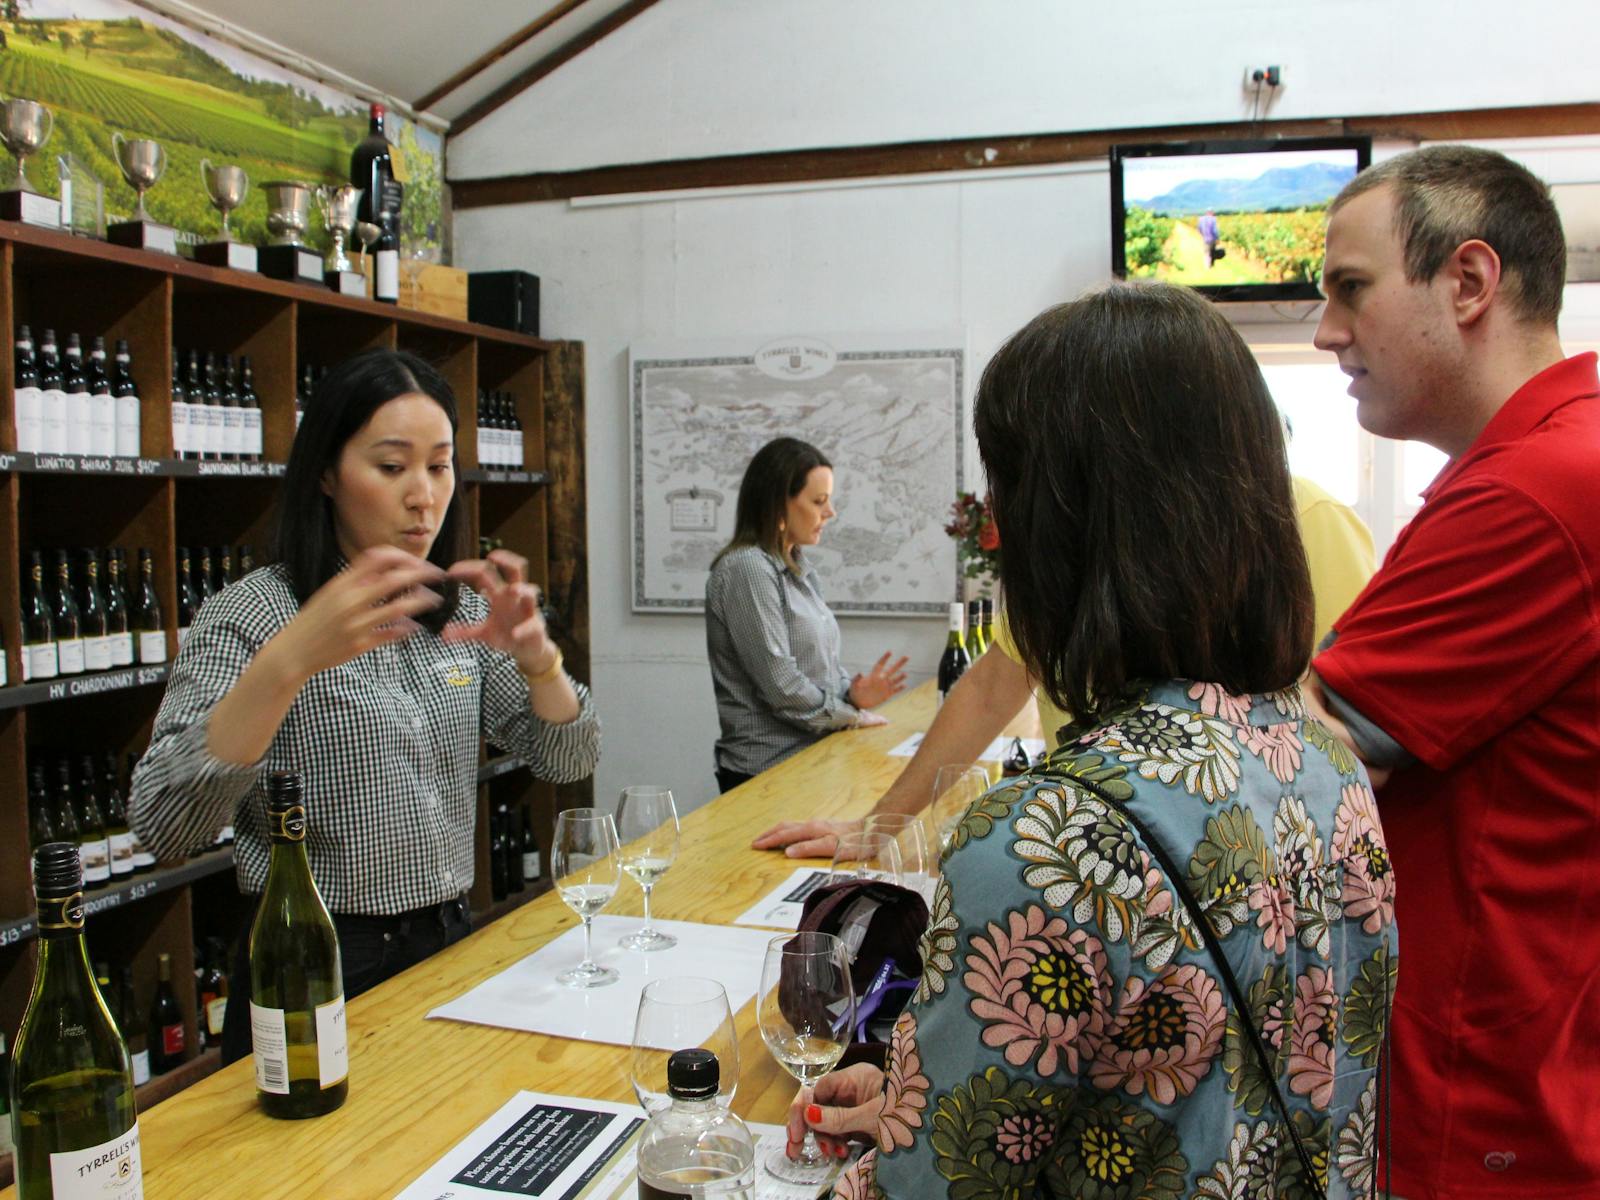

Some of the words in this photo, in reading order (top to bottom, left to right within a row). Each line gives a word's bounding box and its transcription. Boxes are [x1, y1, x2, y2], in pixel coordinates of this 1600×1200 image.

[35, 455, 75, 471] LUNATIQ
[49, 683, 65, 699] HV
[70, 672, 133, 695] CHARDONNAY
[78, 1141, 130, 1177] TYRRELL'S
[463, 1162, 488, 1178] Please
[483, 1145, 506, 1162] choose
[499, 1127, 527, 1146] between
[479, 1166, 505, 1184] tasting
[516, 1134, 536, 1146] Both
[531, 1118, 555, 1134] tasting
[506, 1148, 538, 1175] redeemable
[535, 1135, 552, 1148] upon
